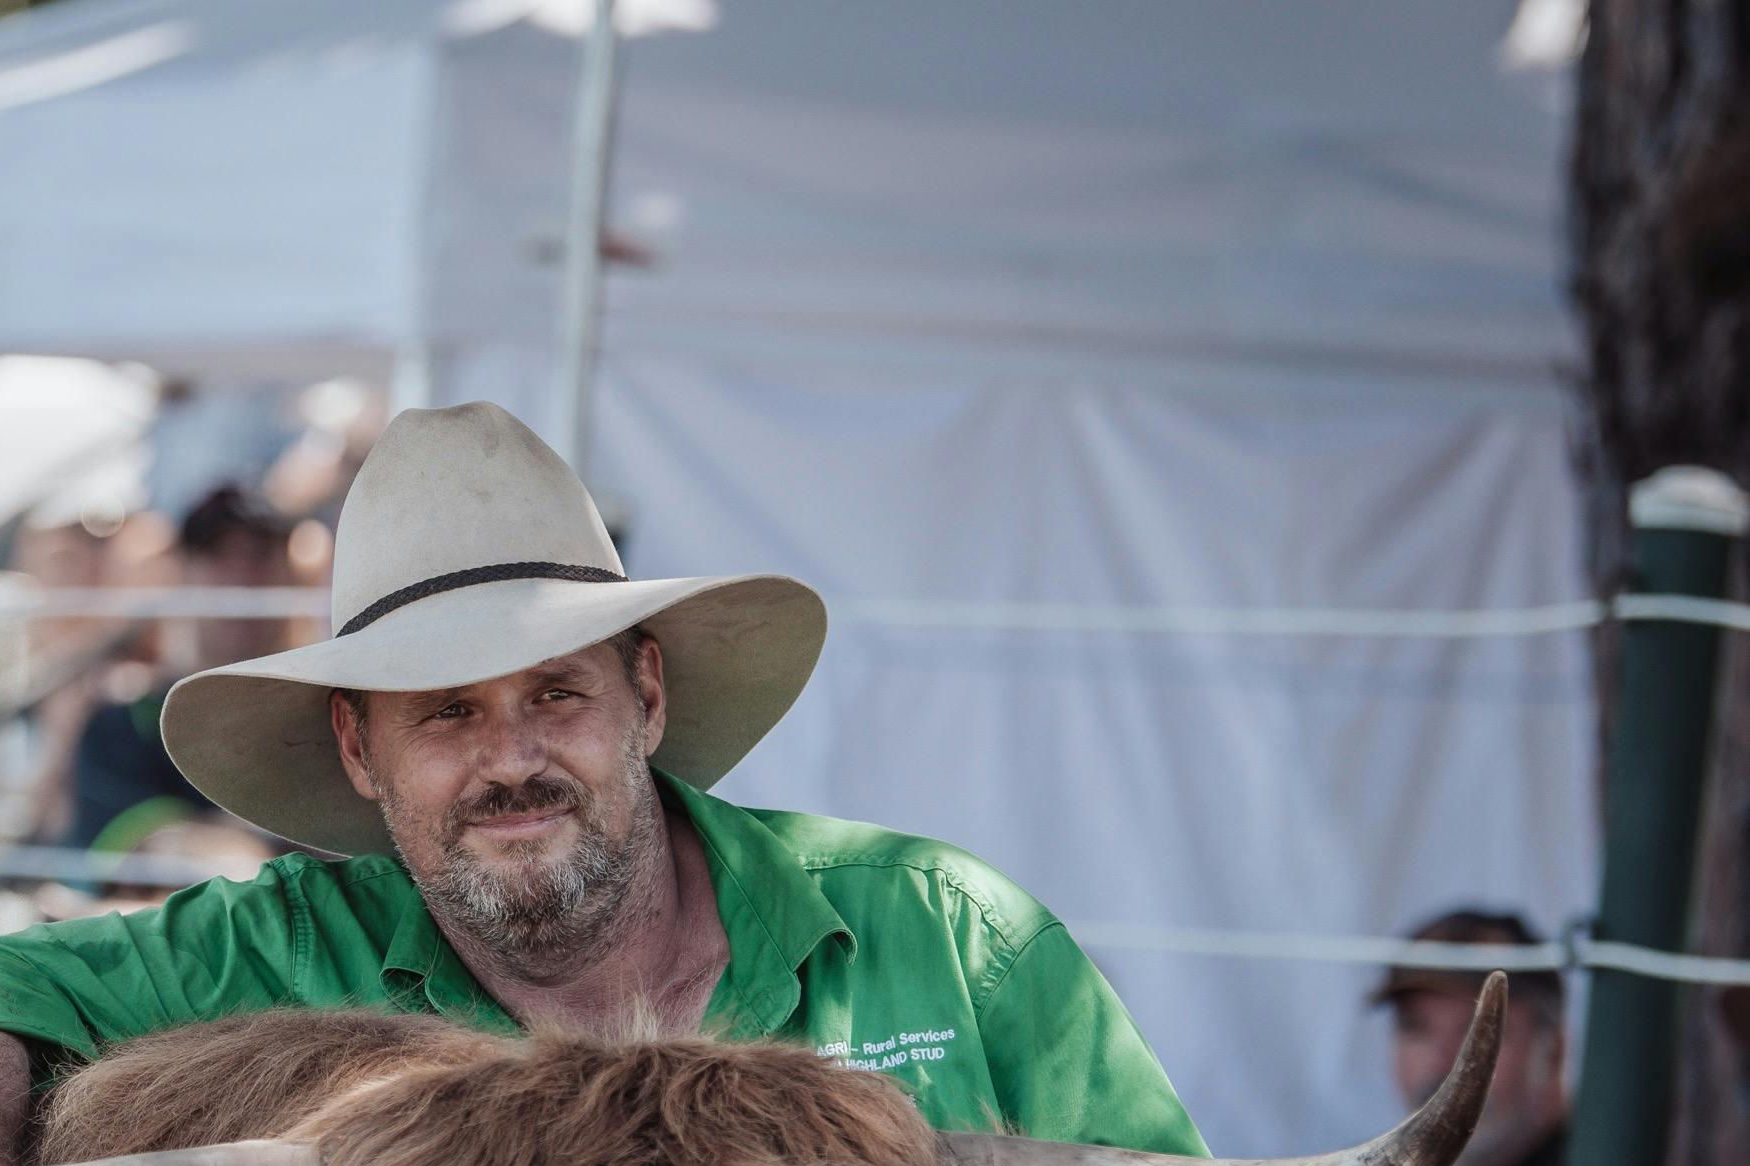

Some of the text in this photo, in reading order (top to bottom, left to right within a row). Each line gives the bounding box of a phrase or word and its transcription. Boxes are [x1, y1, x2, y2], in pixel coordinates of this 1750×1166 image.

[863, 1036, 896, 1055] Rural
[899, 1028, 955, 1045] Services
[846, 1051, 907, 1072] HIGHLAND
[911, 1047, 945, 1062] STUD
